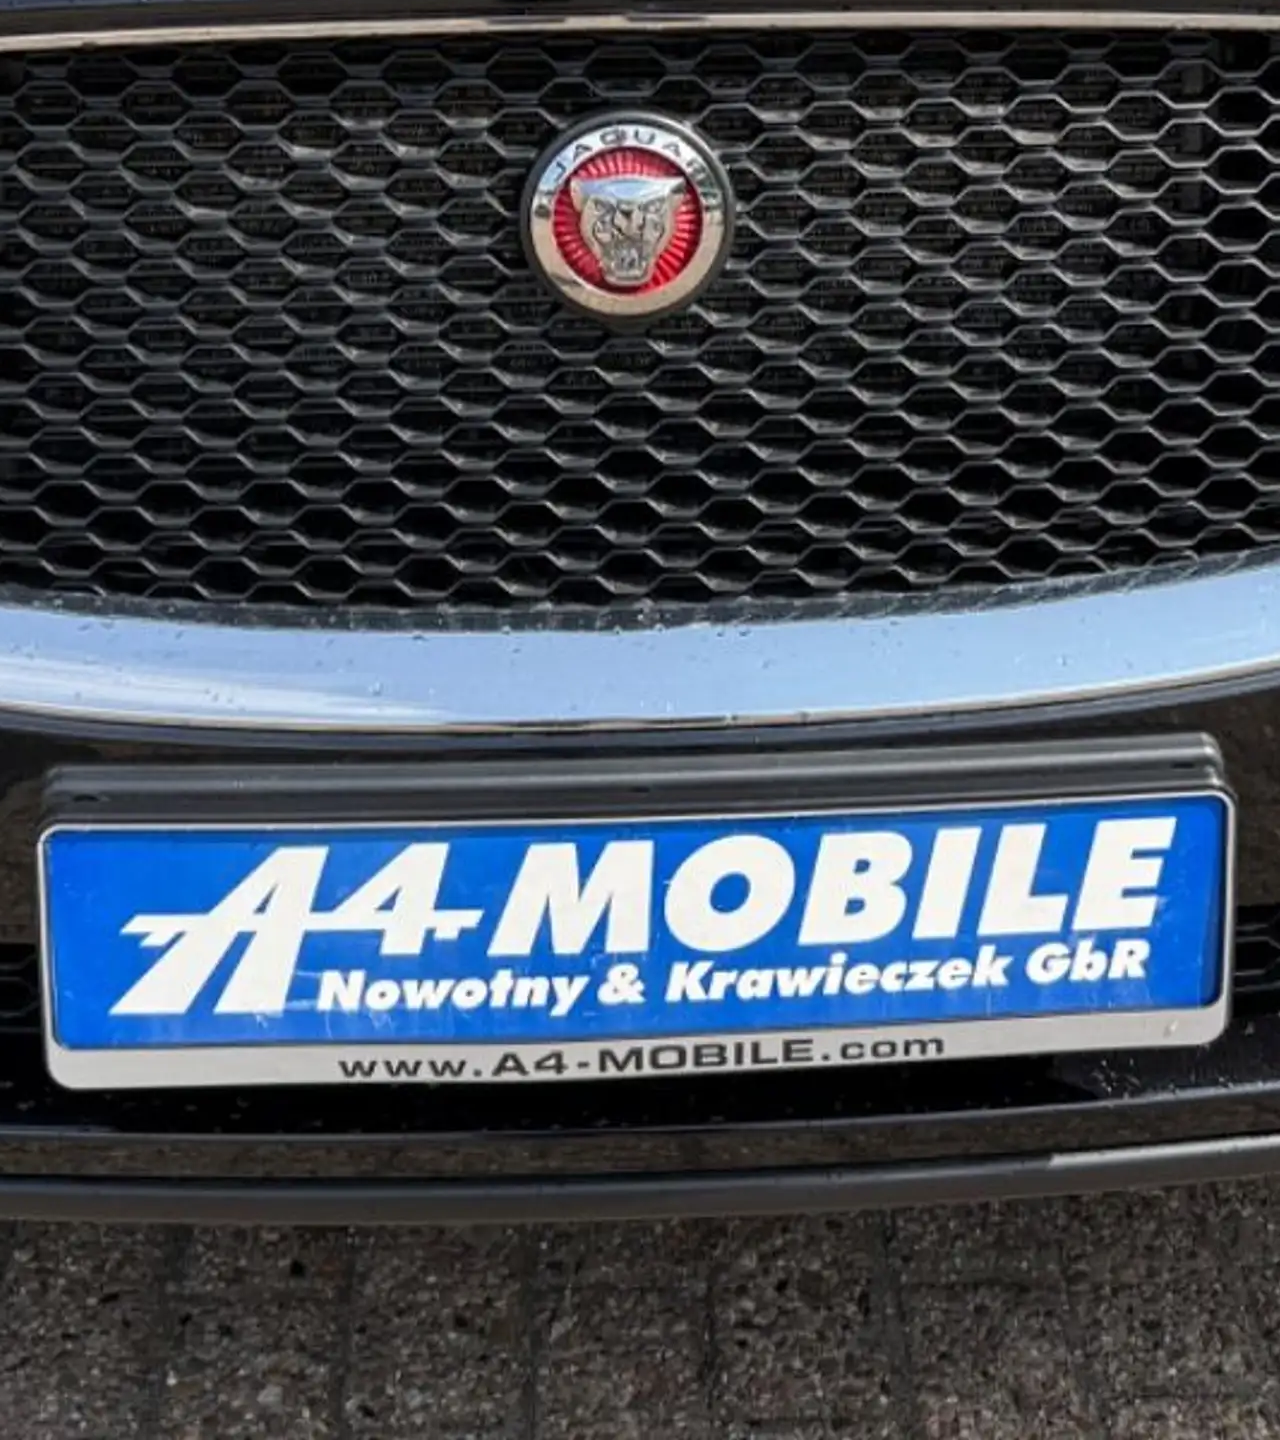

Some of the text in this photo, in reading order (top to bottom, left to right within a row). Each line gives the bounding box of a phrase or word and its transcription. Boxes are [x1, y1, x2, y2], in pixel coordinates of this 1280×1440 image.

[552, 128, 708, 184] JAGUAR
[317, 939, 1151, 1017] Nowotny & Krawieczek GbR
[340, 1036, 945, 1079] www.A4-MOBILE.com
